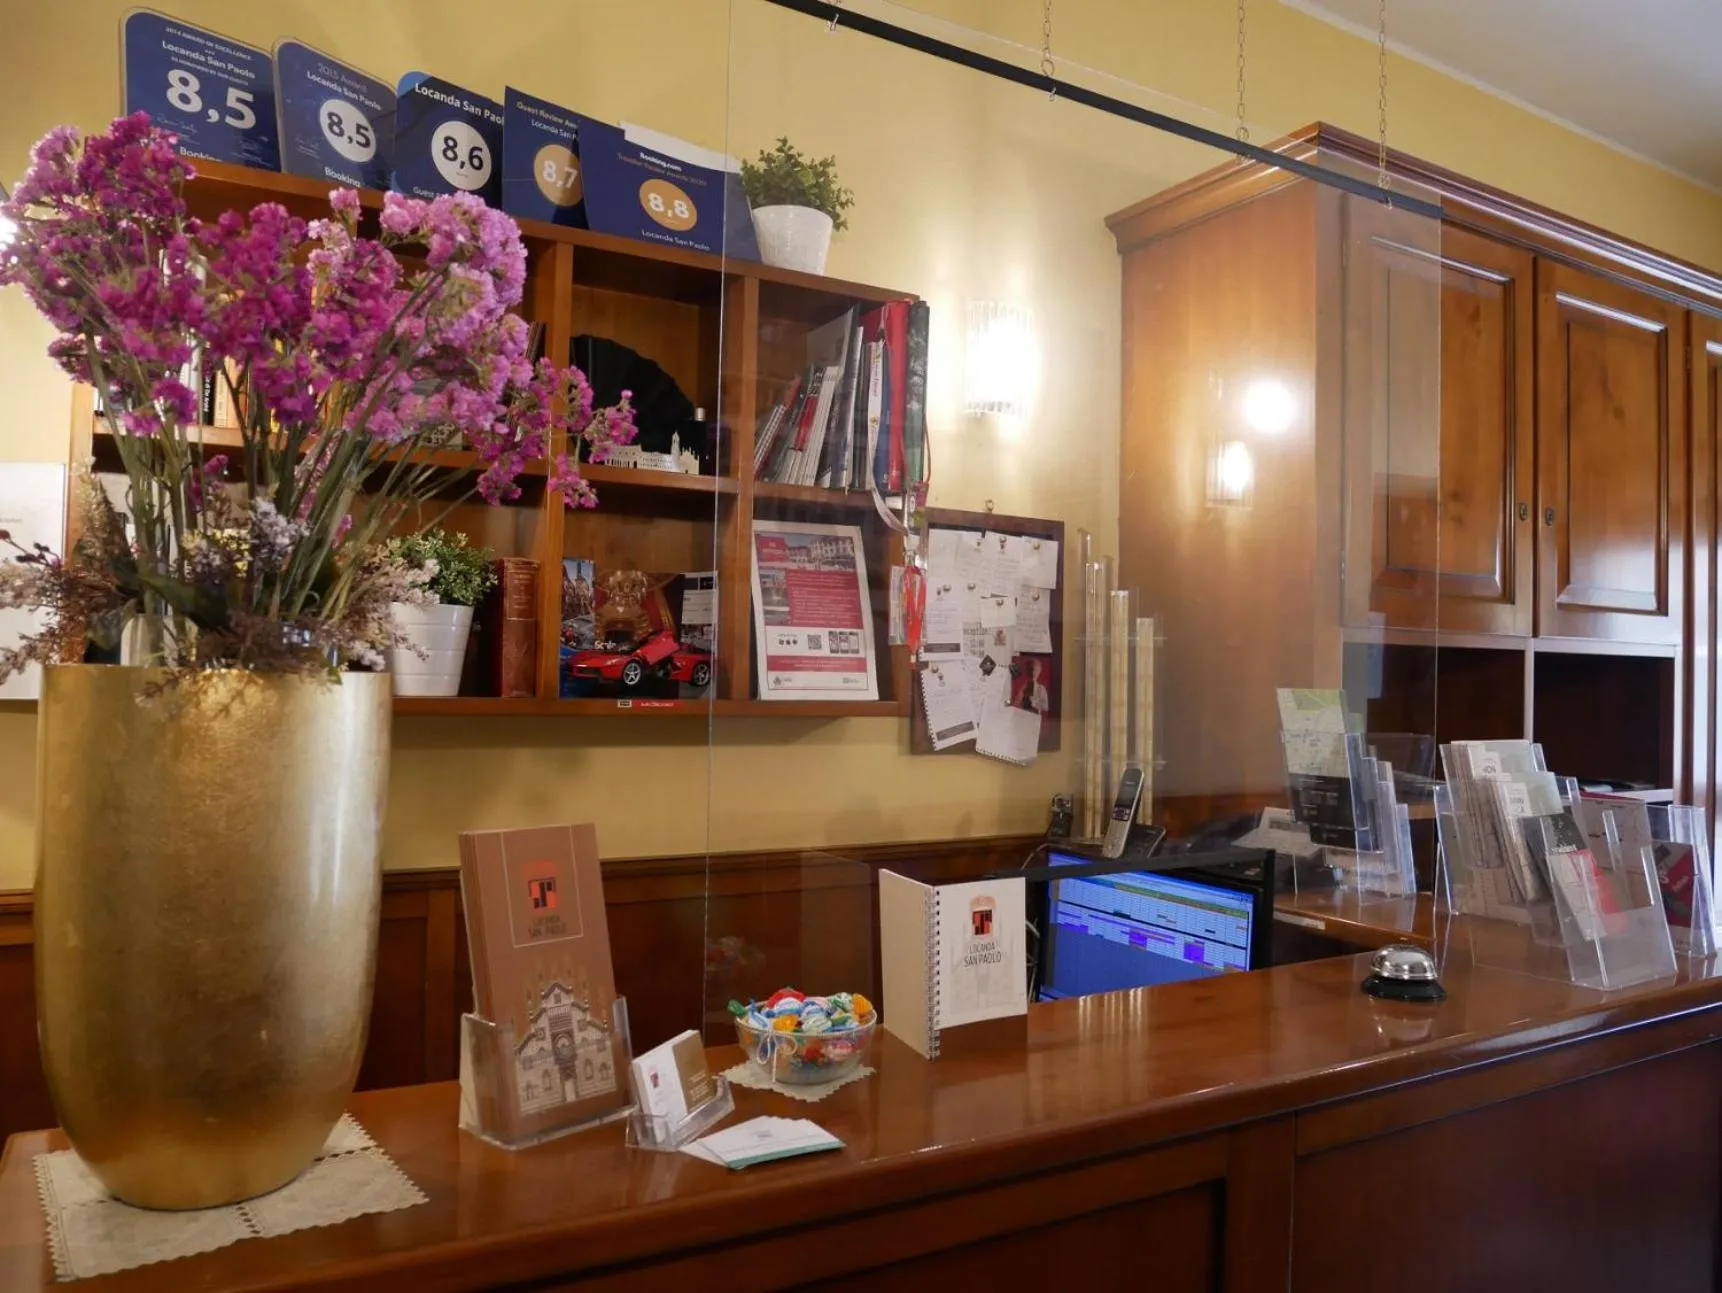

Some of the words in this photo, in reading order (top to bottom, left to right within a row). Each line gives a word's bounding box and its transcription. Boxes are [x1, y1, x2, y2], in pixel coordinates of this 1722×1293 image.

[162, 40, 205, 61] Locanda
[207, 56, 226, 69] San
[227, 62, 256, 79] Paolo
[166, 68, 256, 129] 8,5
[306, 70, 342, 93] Locanda
[343, 86, 358, 101] San
[360, 95, 381, 111] Paolo
[414, 83, 461, 109] Locanda
[462, 100, 482, 115] San
[484, 109, 504, 126] Paol
[516, 100, 538, 115] Guest
[539, 109, 565, 124] Review
[327, 111, 371, 148] 8,5
[531, 118, 559, 135] Locanda
[559, 127, 572, 138] San
[442, 135, 484, 170] 8,6
[640, 151, 682, 171] Booking.com
[542, 160, 579, 190] 8,7
[648, 192, 690, 219] 8,8
[641, 228, 674, 242] Locanda
[674, 235, 689, 246] San
[689, 240, 711, 251] Paolo
[963, 955, 978, 968] SAN
[978, 951, 1002, 964] PAOLO
[969, 941, 995, 953] LOCANDA
